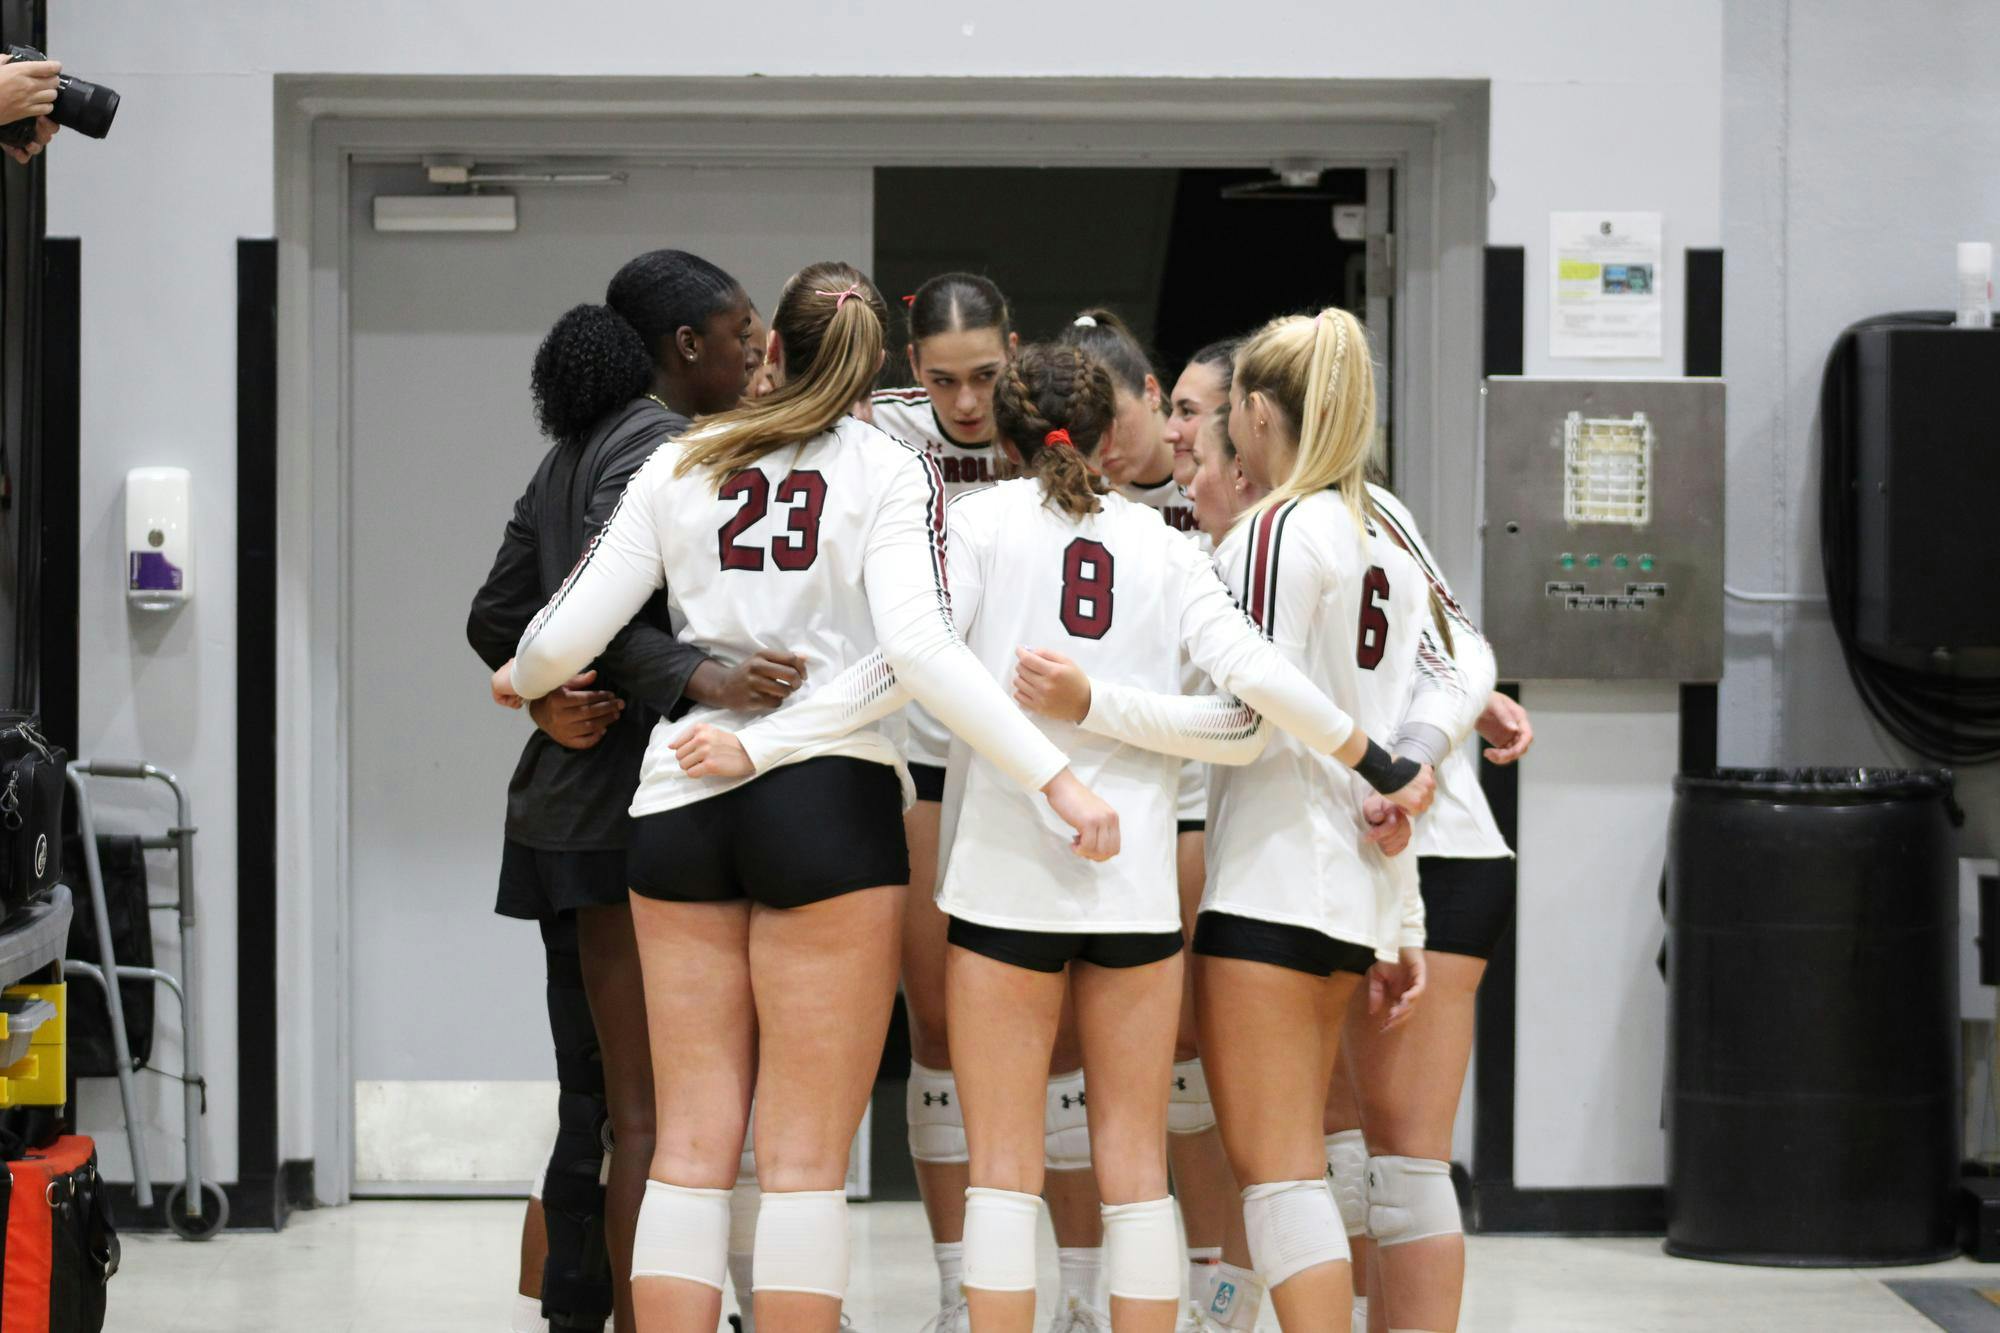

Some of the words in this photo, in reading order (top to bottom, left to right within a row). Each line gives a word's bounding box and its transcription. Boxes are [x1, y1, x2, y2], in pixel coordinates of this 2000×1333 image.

[718, 467, 828, 572] 23
[1059, 536, 1115, 641] 8
[1356, 564, 1390, 671] 6
